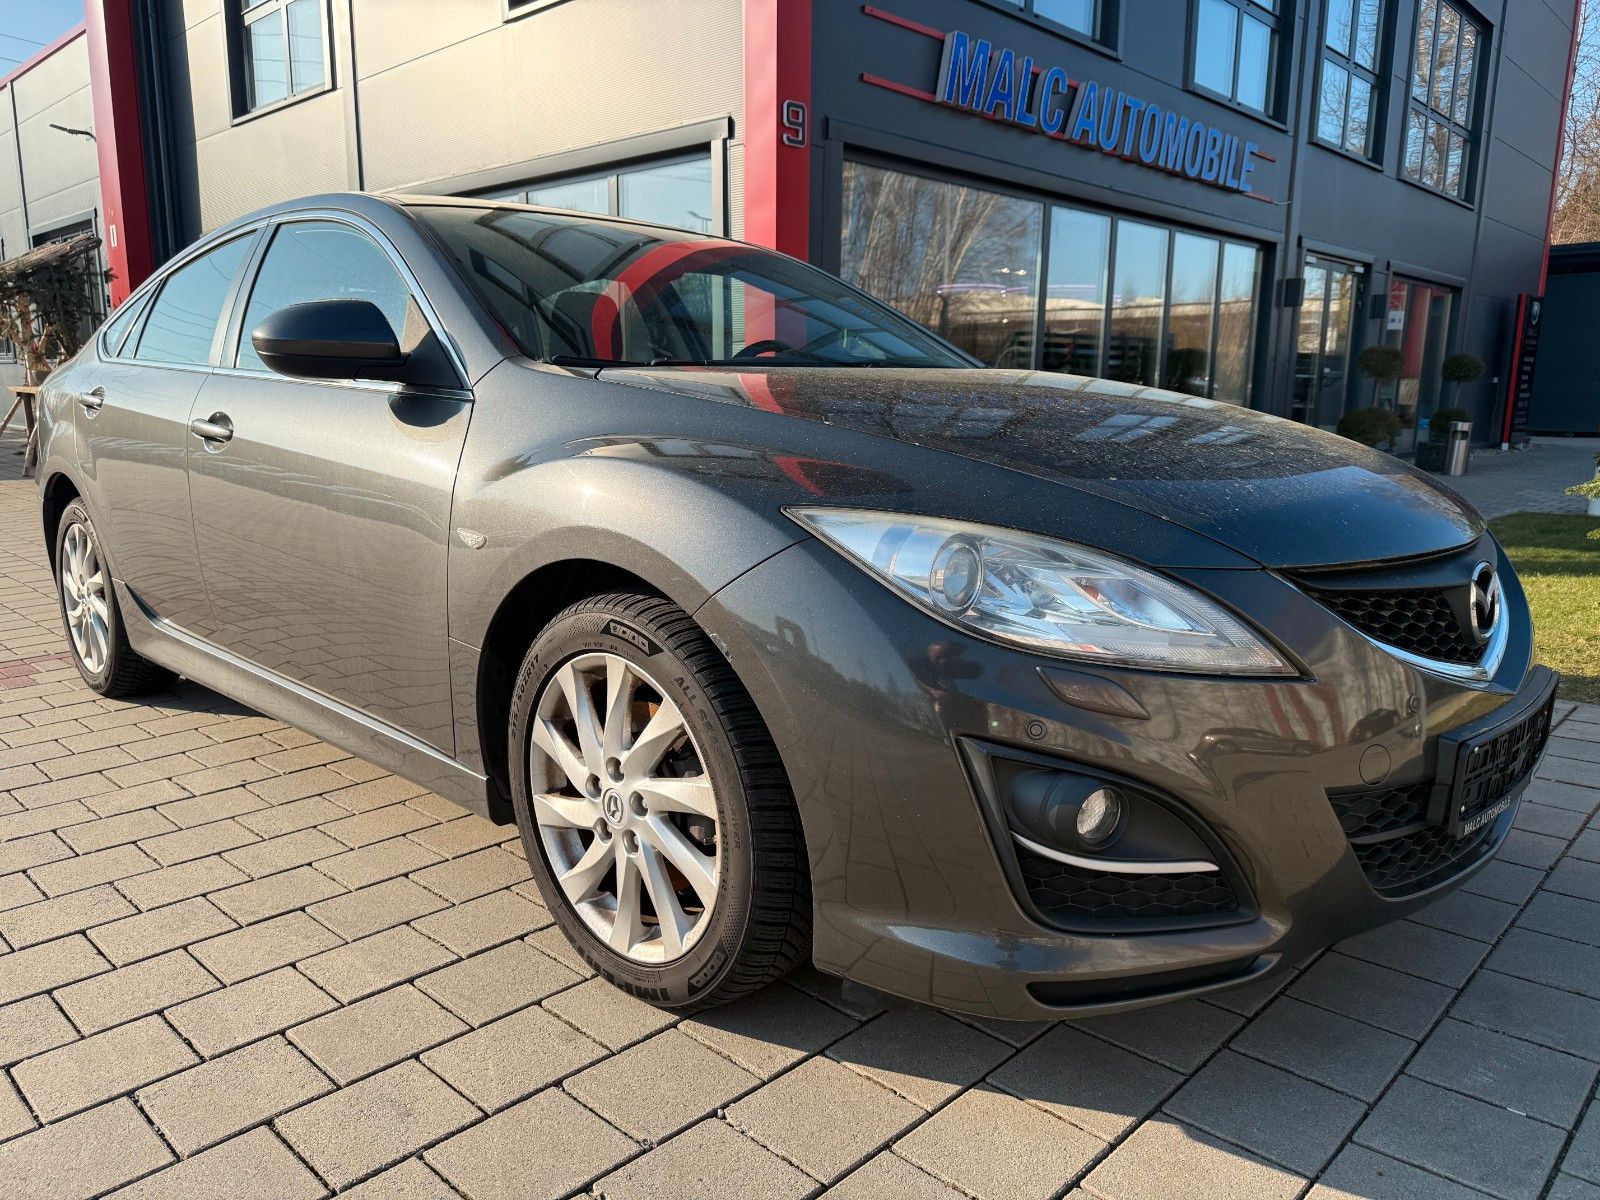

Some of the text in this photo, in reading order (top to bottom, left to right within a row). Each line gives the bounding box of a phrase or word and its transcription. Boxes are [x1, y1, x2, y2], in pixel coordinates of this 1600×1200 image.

[783, 99, 807, 148] 9
[940, 30, 1258, 192] MALC AUTOMOBILE
[673, 676, 697, 706] ALL
